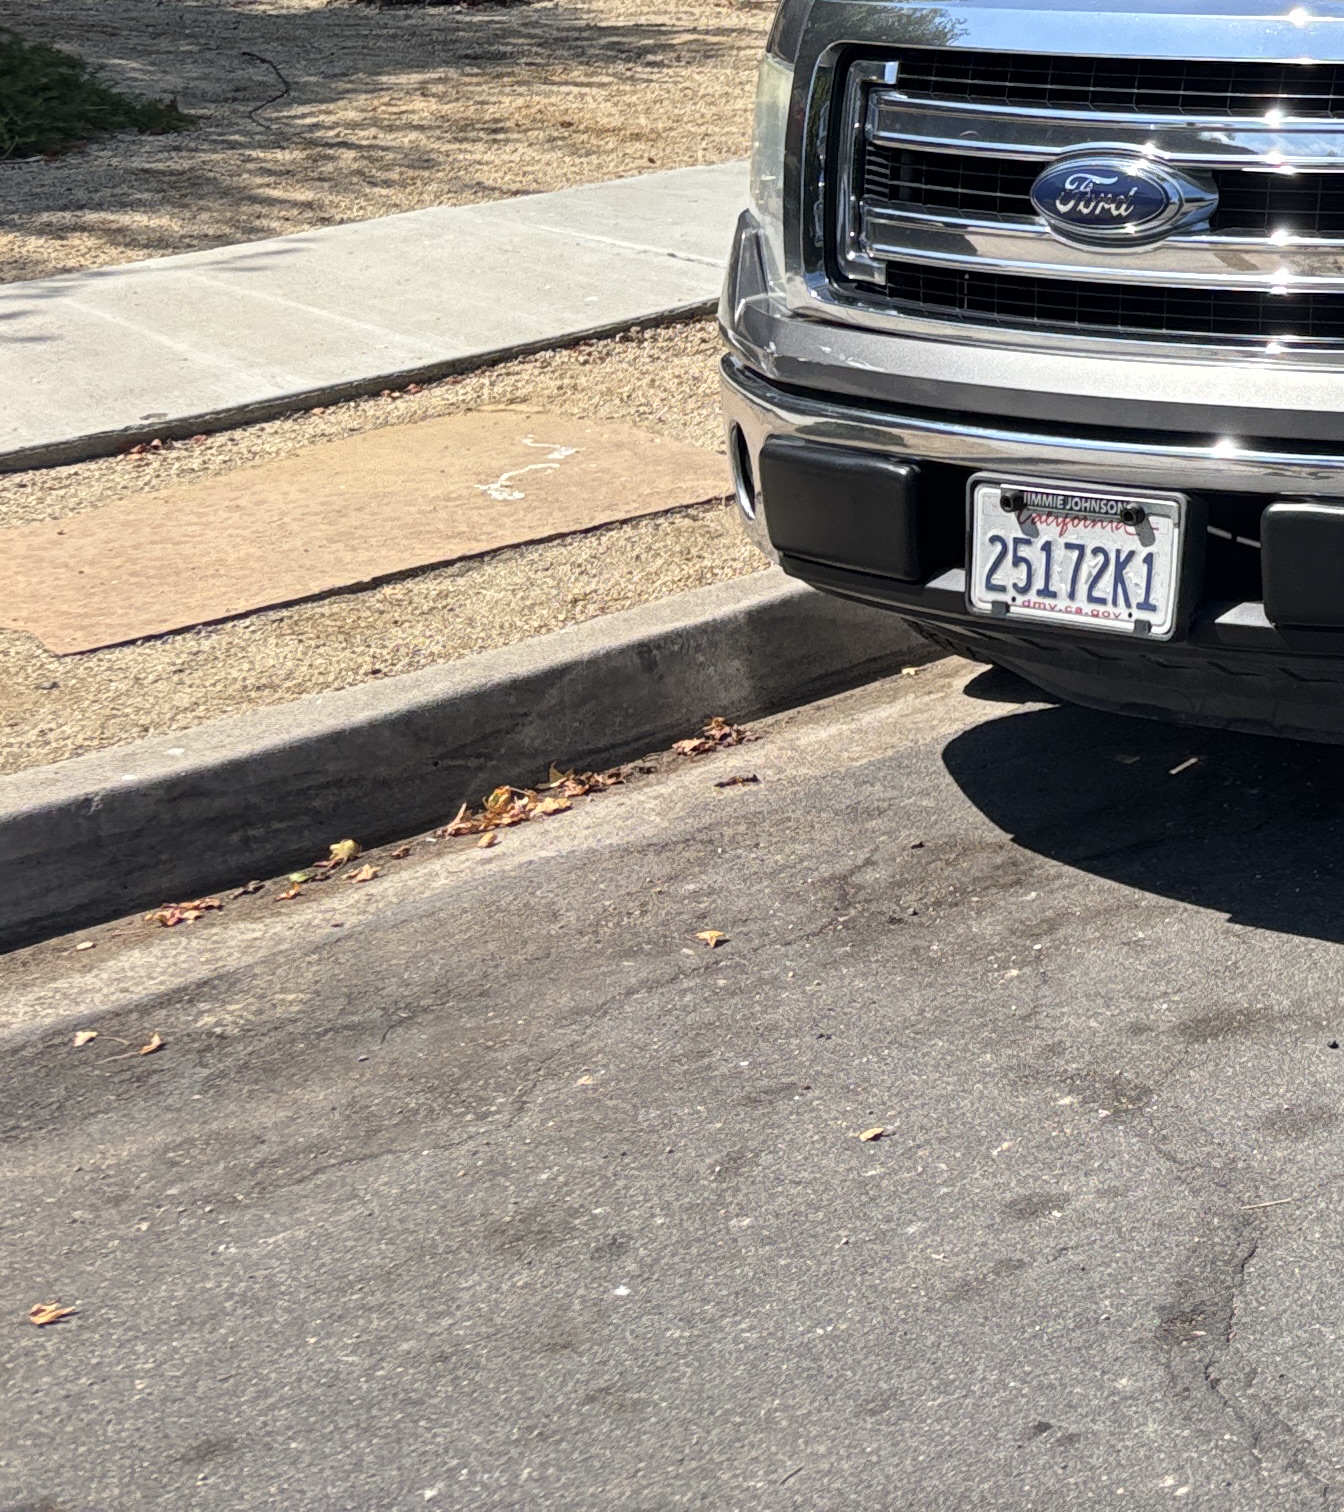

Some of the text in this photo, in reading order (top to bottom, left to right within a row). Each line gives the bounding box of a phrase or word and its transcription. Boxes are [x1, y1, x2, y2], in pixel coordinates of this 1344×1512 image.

[1056, 173, 1138, 216] Ford
[1023, 491, 1065, 509] JIMMIE
[1017, 507, 1137, 537] California
[985, 534, 1157, 613] 25172K1
[1022, 599, 1122, 619] dmv.ca.gov
